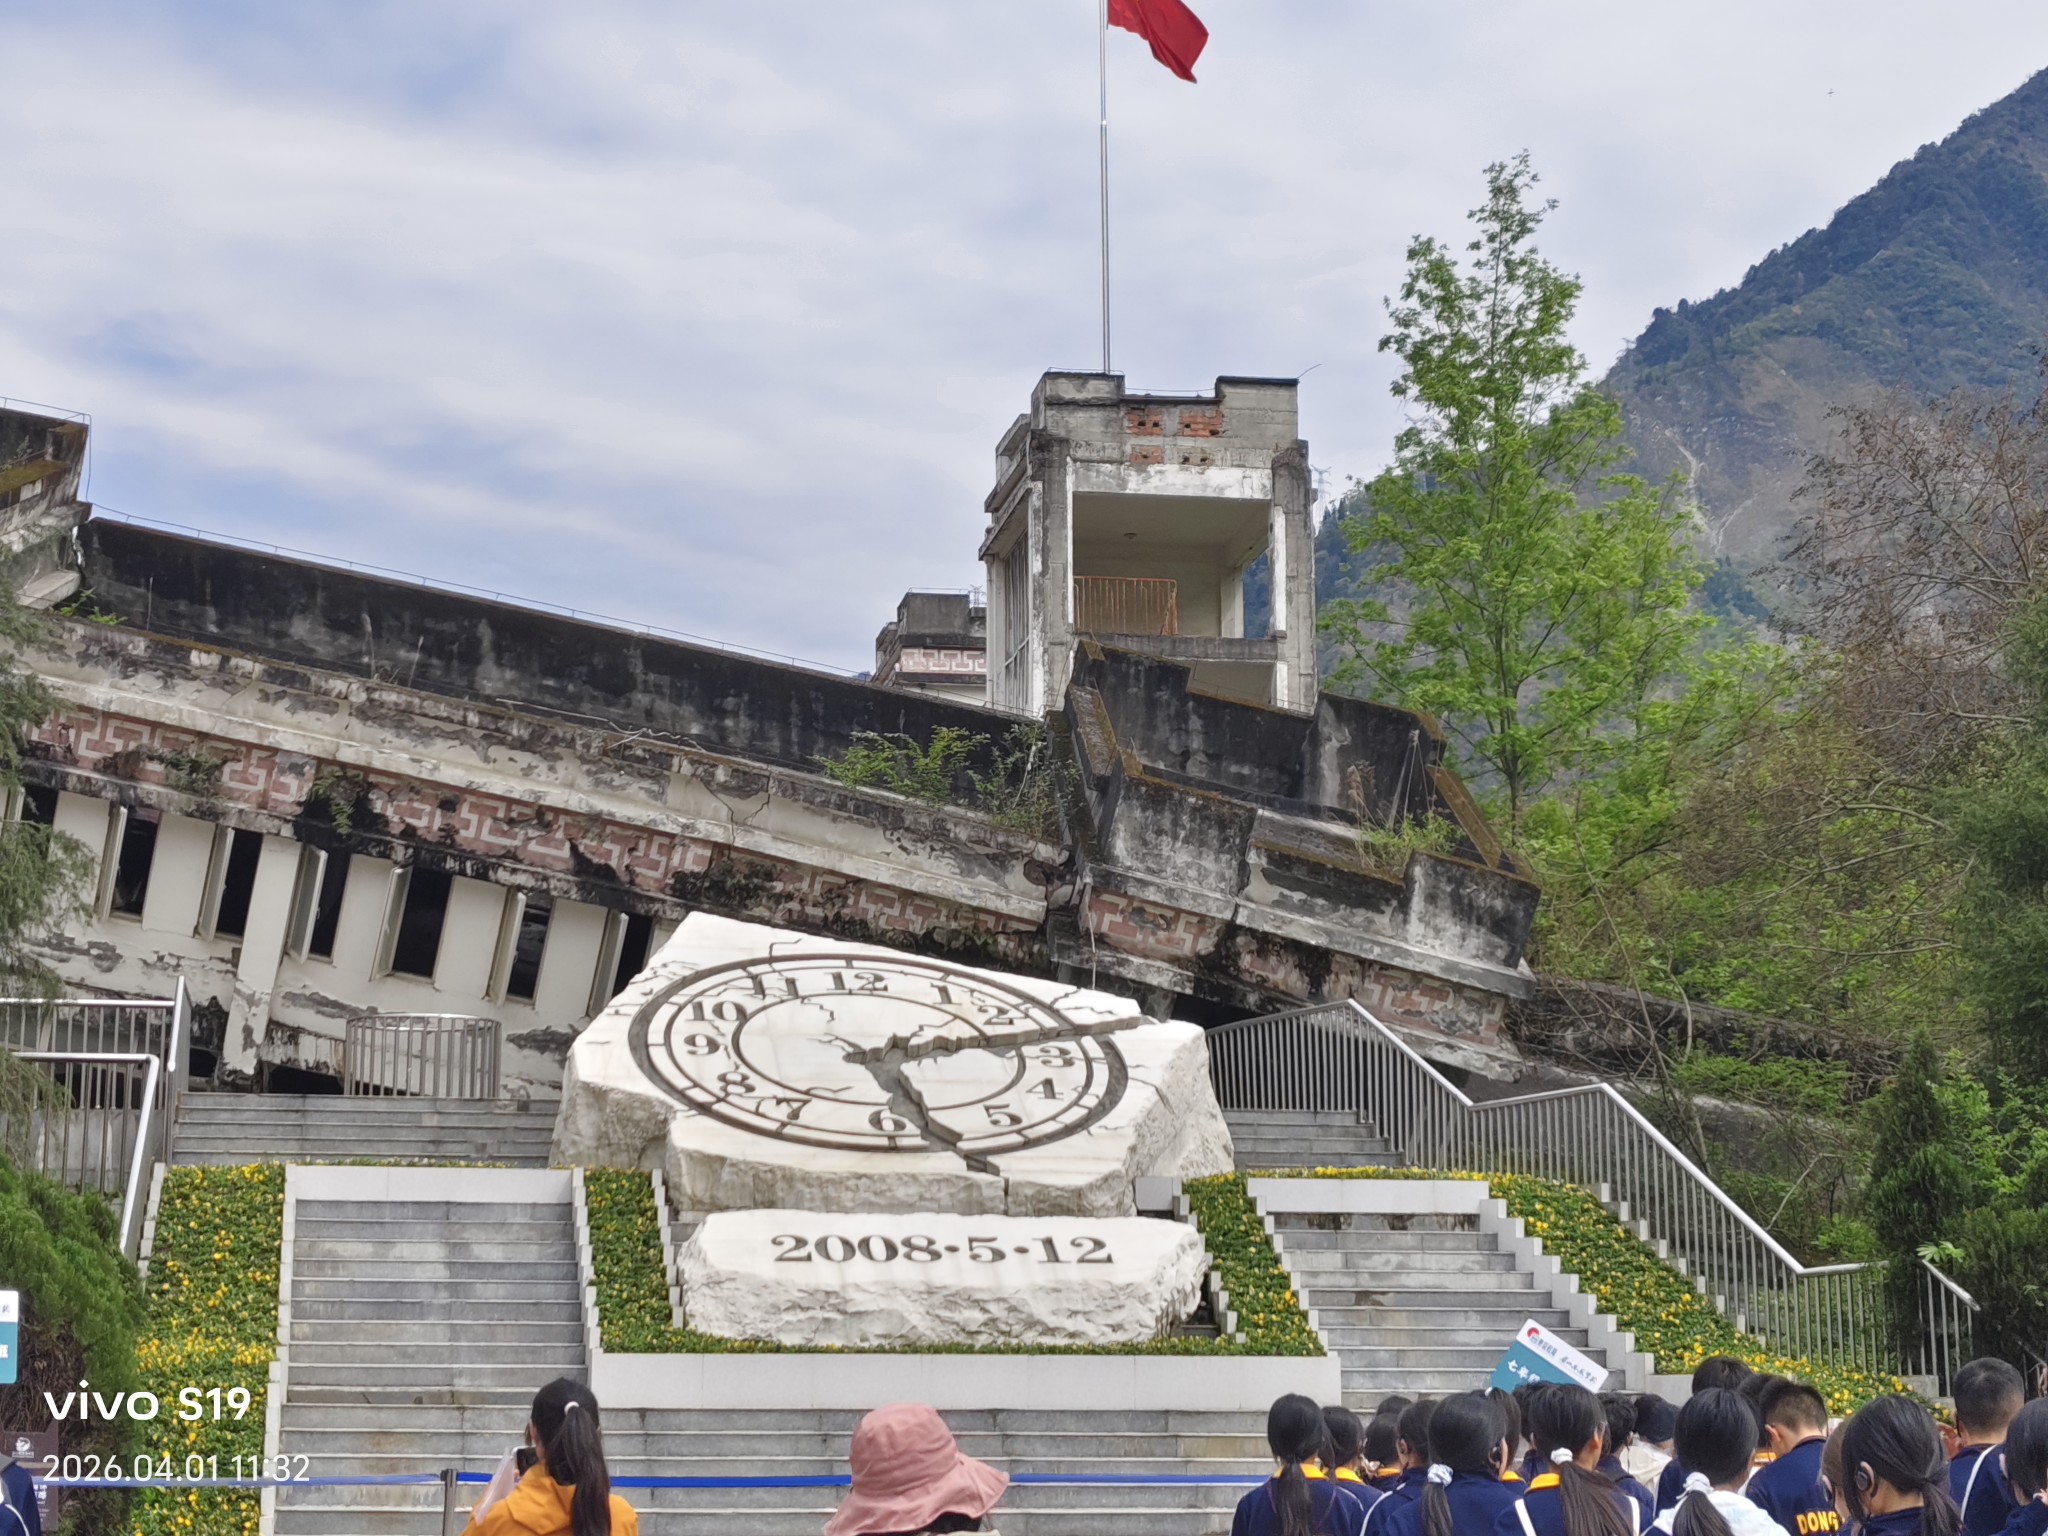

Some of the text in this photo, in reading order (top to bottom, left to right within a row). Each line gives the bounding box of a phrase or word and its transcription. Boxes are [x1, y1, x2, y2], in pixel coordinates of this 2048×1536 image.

[748, 974, 802, 1000] 11
[823, 972, 888, 991] 12
[931, 983, 962, 1004] 1
[685, 1000, 748, 1021] 10
[977, 1004, 1014, 1025] 2
[684, 1034, 720, 1055] 9
[1039, 1045, 1075, 1068] 3
[717, 1071, 756, 1094] 8
[1026, 1078, 1064, 1100] 4
[774, 1096, 812, 1120] 7
[983, 1104, 1023, 1127] 5
[868, 1109, 907, 1132] 6
